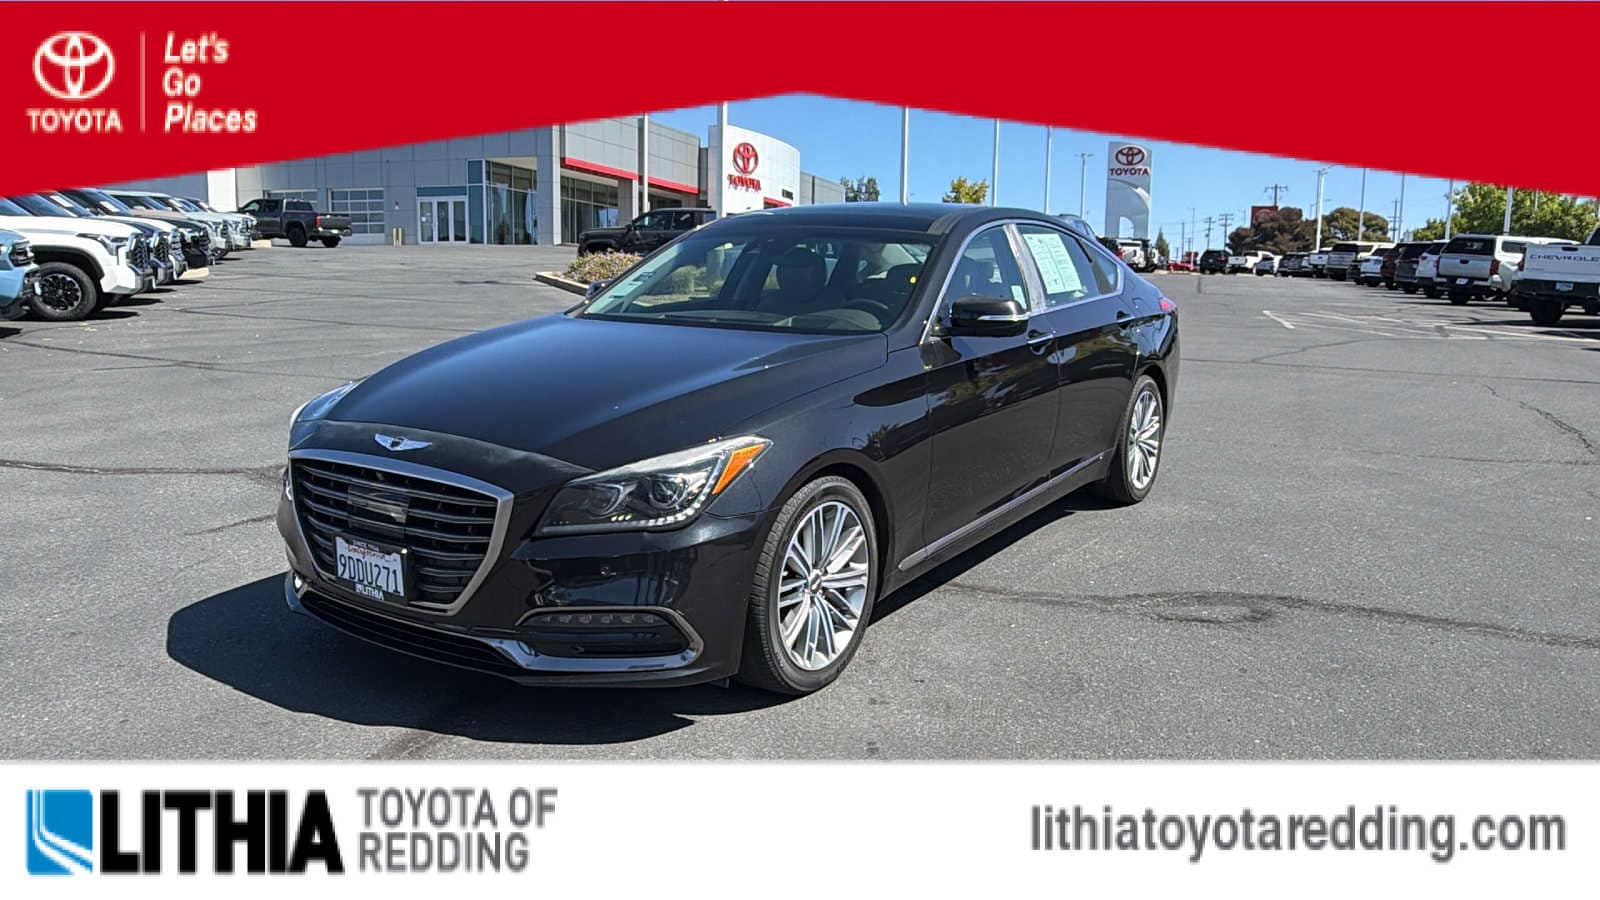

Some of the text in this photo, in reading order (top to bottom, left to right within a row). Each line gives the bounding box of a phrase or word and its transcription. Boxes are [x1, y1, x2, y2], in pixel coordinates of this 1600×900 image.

[1109, 167, 1150, 176] TOYOTA
[727, 174, 762, 192] TOYOTA
[339, 553, 401, 594] 9DDU271
